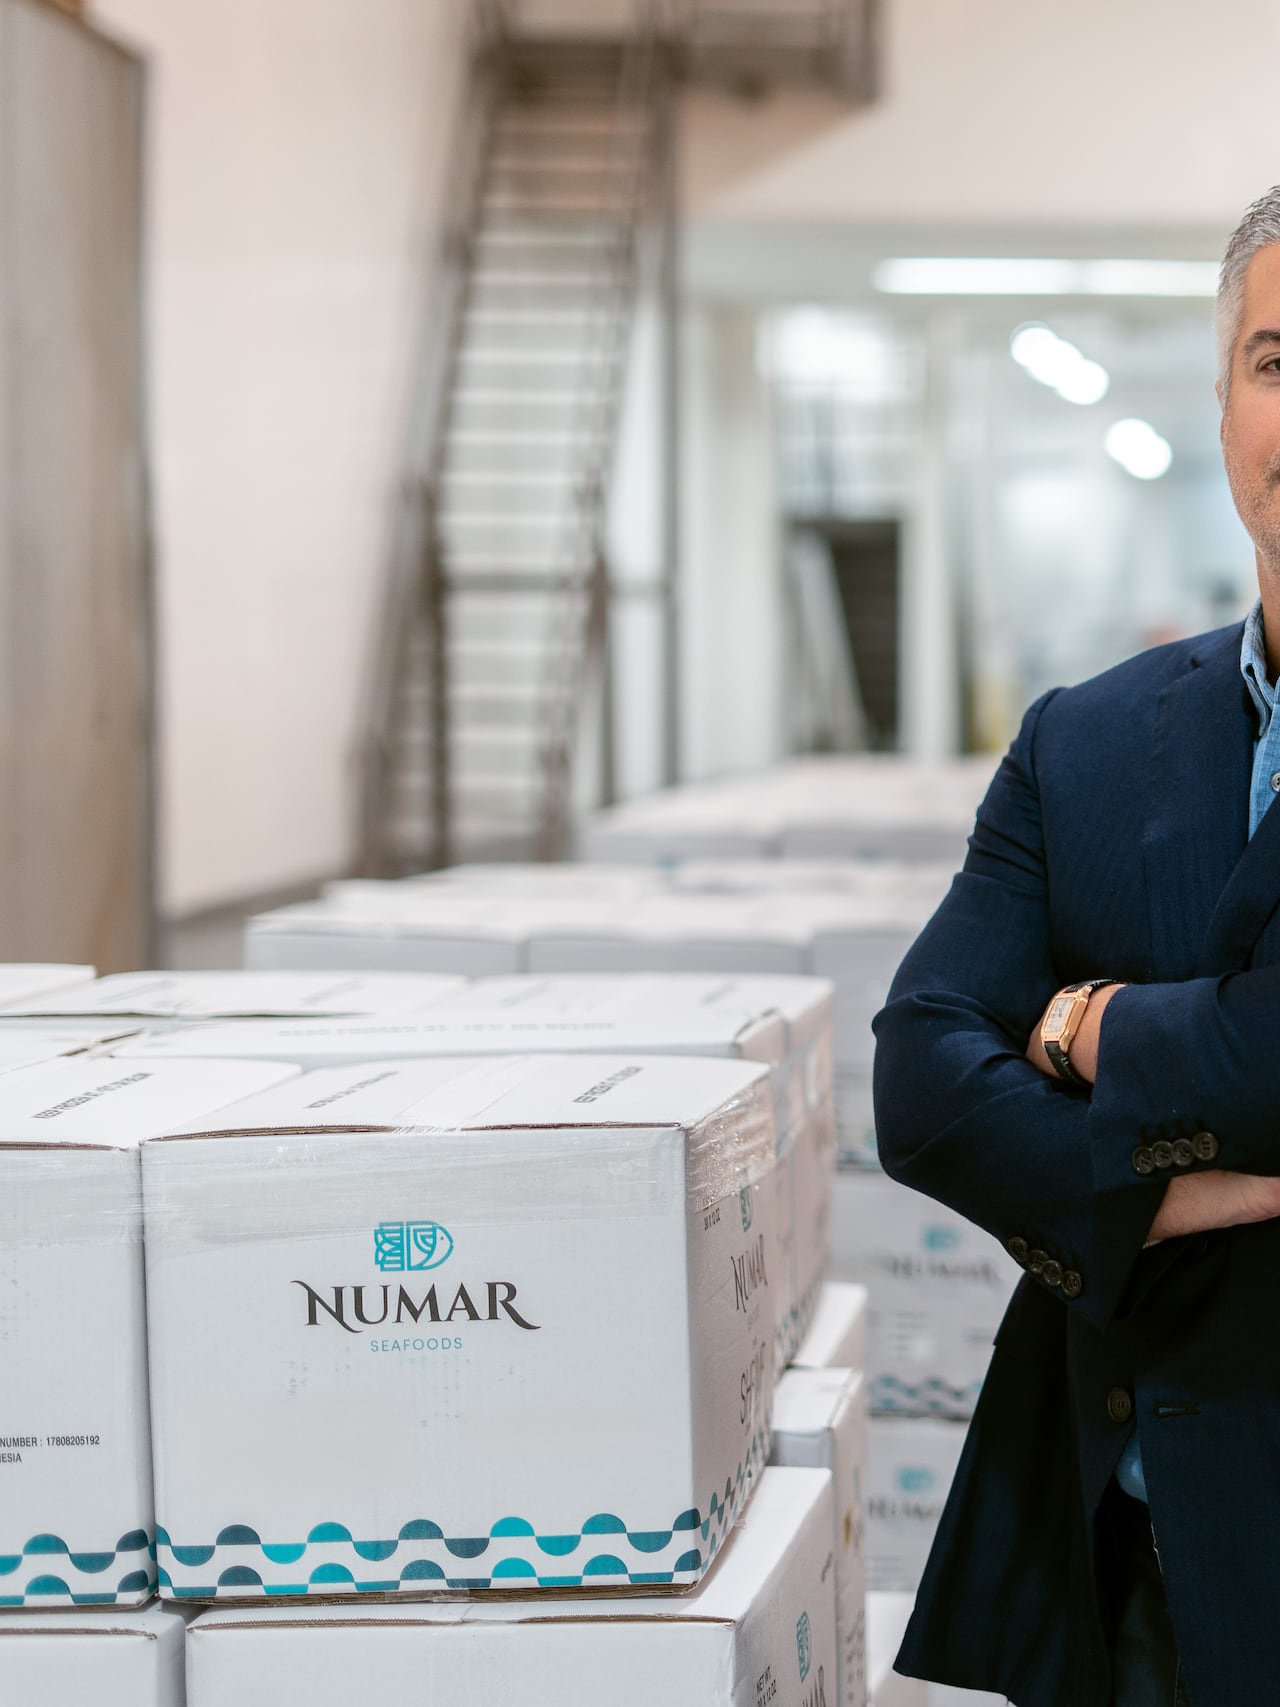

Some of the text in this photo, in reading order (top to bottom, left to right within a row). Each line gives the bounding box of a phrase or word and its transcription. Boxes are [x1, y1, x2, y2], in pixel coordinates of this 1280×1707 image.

[290, 1280, 542, 1334] NUMAR
[370, 1336, 463, 1352] SEAFOODS
[0, 1436, 38, 1448] NUMBER
[46, 1435, 100, 1447] 17808205192
